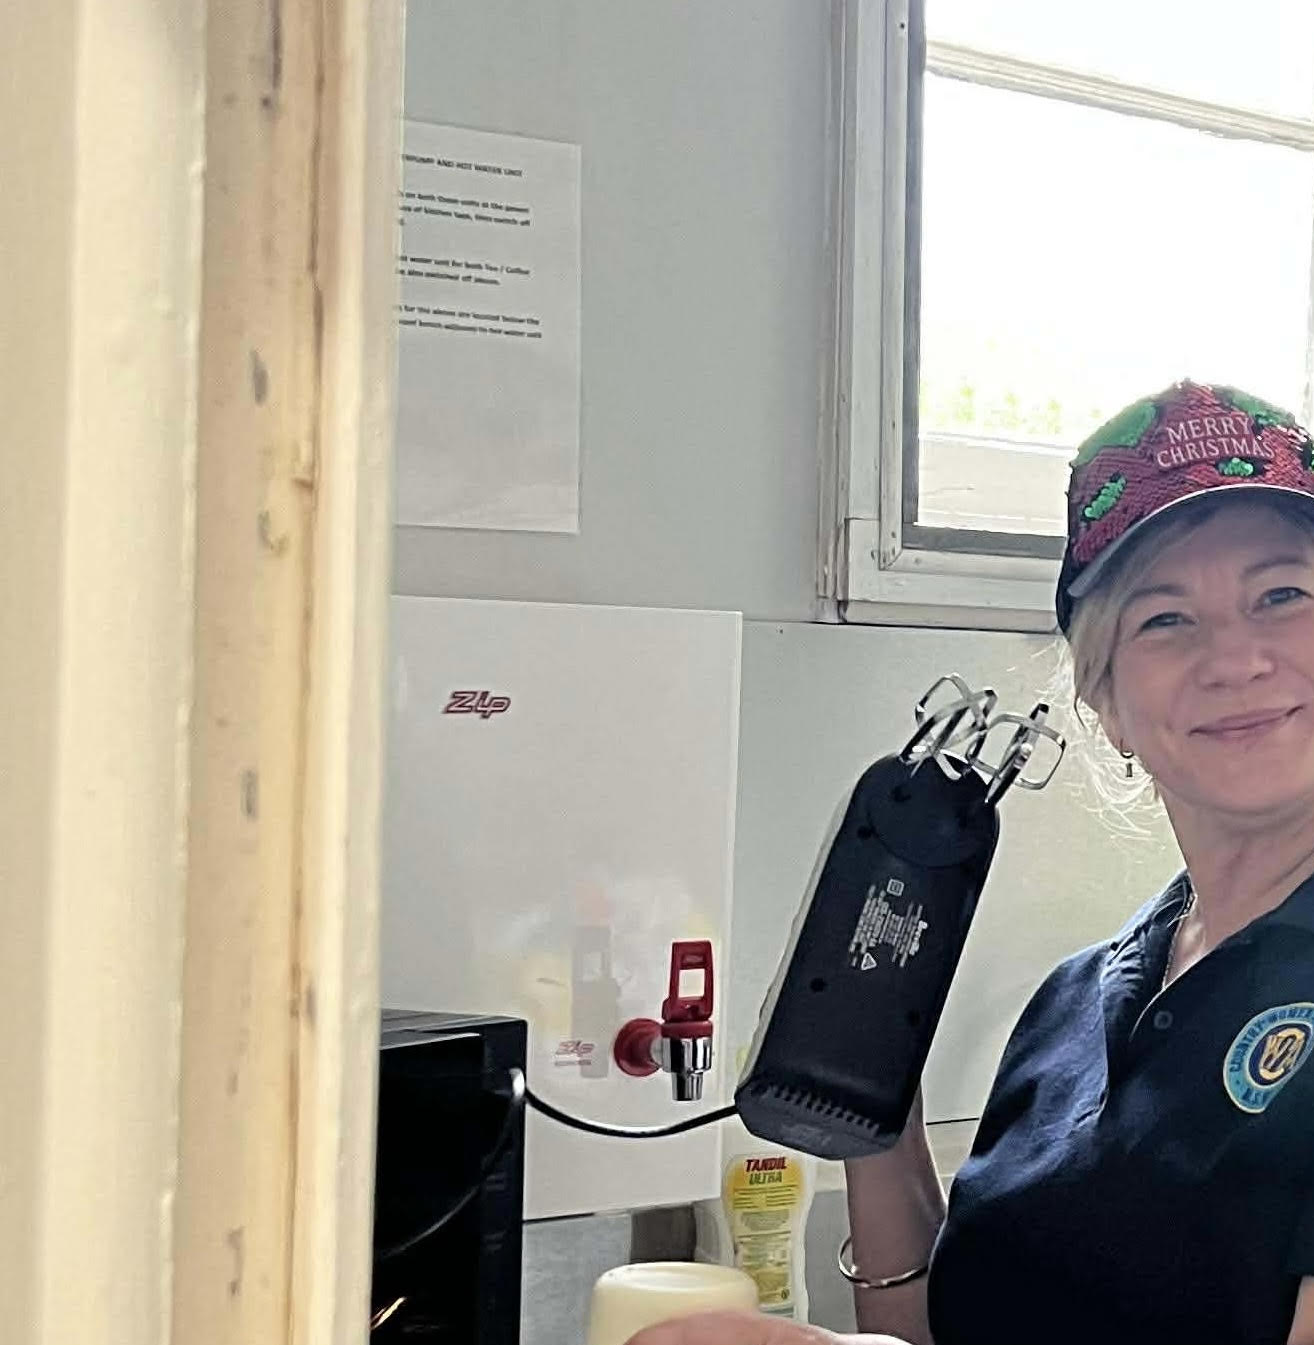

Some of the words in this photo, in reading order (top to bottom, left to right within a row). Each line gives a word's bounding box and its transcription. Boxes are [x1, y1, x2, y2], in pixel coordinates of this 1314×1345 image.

[1167, 416, 1253, 445] MERRY
[1156, 437, 1276, 469] CHRISTMAS
[744, 1156, 787, 1173] TANDIL
[749, 1170, 783, 1186] ULTRA
